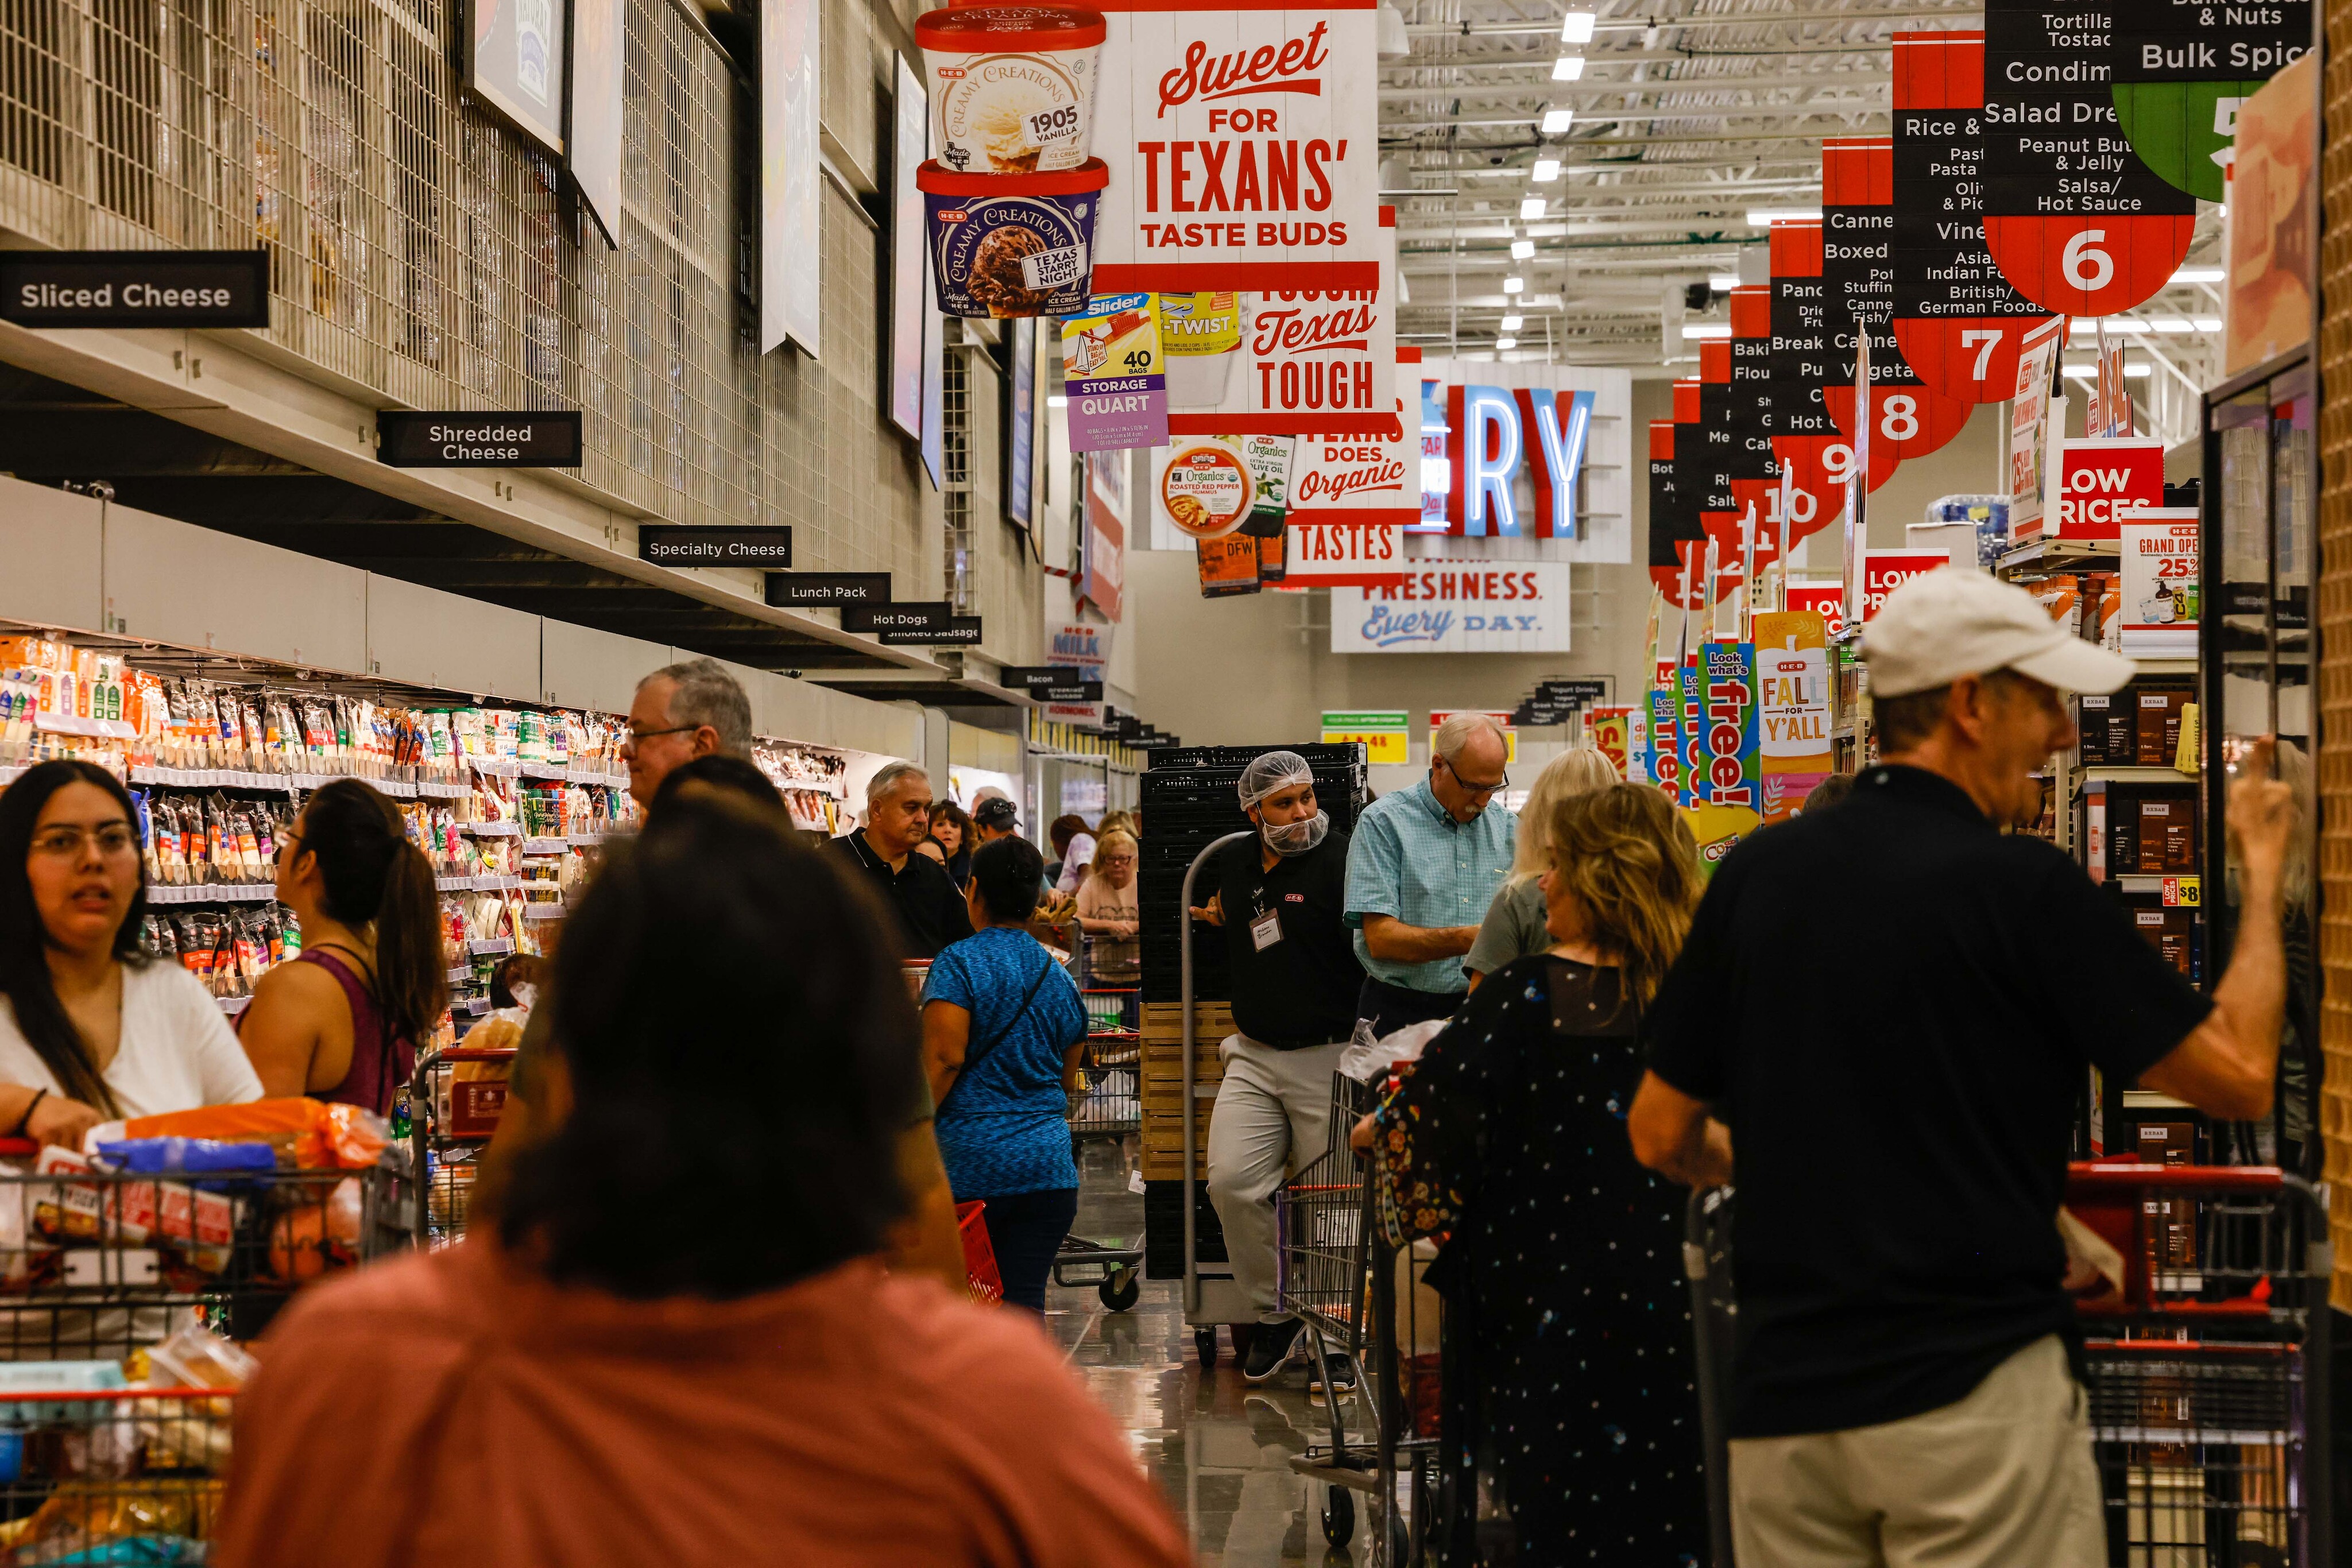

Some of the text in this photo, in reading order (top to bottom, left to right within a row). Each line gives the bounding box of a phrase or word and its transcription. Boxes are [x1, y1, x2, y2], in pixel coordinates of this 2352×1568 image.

[2199, 7, 2282, 25] & Nuts
[2142, 43, 2216, 69] Bulk
[1158, 20, 1328, 119] Sweet
[951, 65, 1065, 137] CREAMY CREATIONS
[1030, 106, 1078, 134] 1905
[1209, 109, 1278, 133] FOR
[1984, 102, 2060, 123] Salad
[1036, 126, 1077, 142] VANILLA
[1906, 118, 1980, 135] Rice &
[2020, 138, 2089, 153] Peanut
[1931, 163, 1977, 176] Pasta
[2056, 155, 2125, 172] & Jelly
[2058, 177, 2122, 195] Salsa/
[1943, 198, 1954, 211] &
[2038, 196, 2142, 211] Hot Sauce
[1831, 213, 1893, 229] Canne
[1140, 223, 1347, 248] TASTE BUDS
[1937, 222, 1986, 239] Vine
[950, 208, 1066, 282] CREAMY CREATIONS
[1825, 243, 1887, 258] Boxed
[1034, 249, 1078, 268] TEXAS
[2061, 230, 2114, 291] 6
[1038, 259, 1077, 276] STARRY
[1927, 266, 1980, 280] Indian
[1039, 268, 1078, 285] NIGHT
[21, 284, 230, 308] Sliced Cheese
[1844, 282, 1892, 293] Stuffin
[1950, 286, 2014, 300] British/
[1088, 294, 1142, 315] Slider
[1847, 299, 1893, 310] Canne
[1920, 300, 2046, 314] German Foods
[1252, 305, 1377, 355] Texas
[1088, 344, 1099, 353] STAND
[1735, 343, 1769, 356] Baki
[1773, 336, 1823, 350] Break
[1090, 358, 1098, 367] EASY
[1124, 350, 1151, 367] 40
[1961, 330, 2003, 381] 7
[1735, 367, 1770, 380] Flou
[1801, 363, 1822, 375] Pu
[1842, 363, 1914, 380] Vgeta
[1082, 379, 1147, 393] STORAGE
[1257, 361, 1372, 409] TOUGH
[1082, 395, 1150, 415] QUART
[1791, 416, 1822, 429] Hot
[1881, 394, 1919, 440] 8
[430, 425, 531, 442] Shredded
[1709, 431, 1730, 443] Me
[443, 444, 519, 459] Cheese
[1248, 442, 1287, 458] Organics
[1324, 447, 1382, 462] DOES
[1822, 444, 1855, 484] 9
[1186, 470, 1224, 483] Organics
[1299, 458, 1406, 501] Organic
[1708, 495, 1736, 506] Salt
[1765, 488, 1817, 523] 10
[650, 542, 786, 557] Specialty Cheese
[1227, 542, 1252, 556] DFW
[1299, 525, 1392, 560] TASTES
[2140, 539, 2173, 553] GRAND
[791, 586, 866, 598] Lunch Pack
[2175, 593, 2185, 615] C4
[873, 614, 928, 626] Hot Dogs
[1361, 606, 1542, 641] Every DAY.
[1053, 633, 1099, 656] MILK
[1710, 652, 1742, 664] Look
[1027, 675, 1053, 683] Bacon
[1763, 676, 1824, 706] FALL
[1708, 679, 1751, 805] free!
